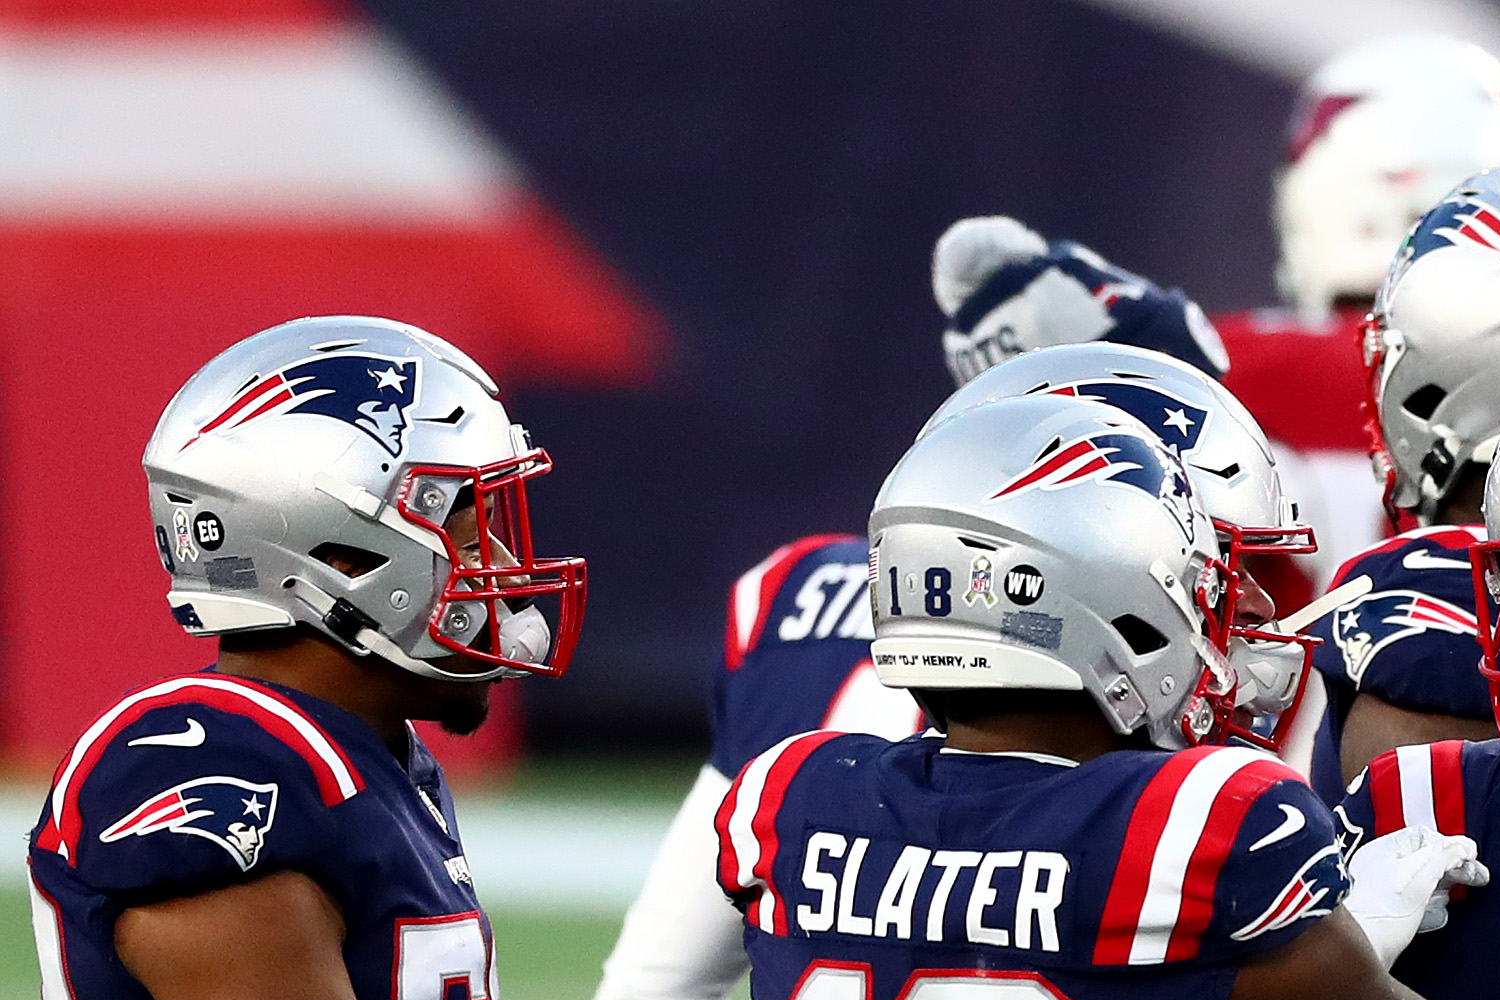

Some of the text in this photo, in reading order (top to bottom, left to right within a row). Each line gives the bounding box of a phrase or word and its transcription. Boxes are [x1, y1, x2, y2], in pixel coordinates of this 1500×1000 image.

[197, 520, 220, 542] EG
[1008, 572, 1043, 598] WW
[922, 655, 966, 669] HENRY,
[970, 657, 991, 669] JR.
[797, 831, 1070, 953] SLATER
